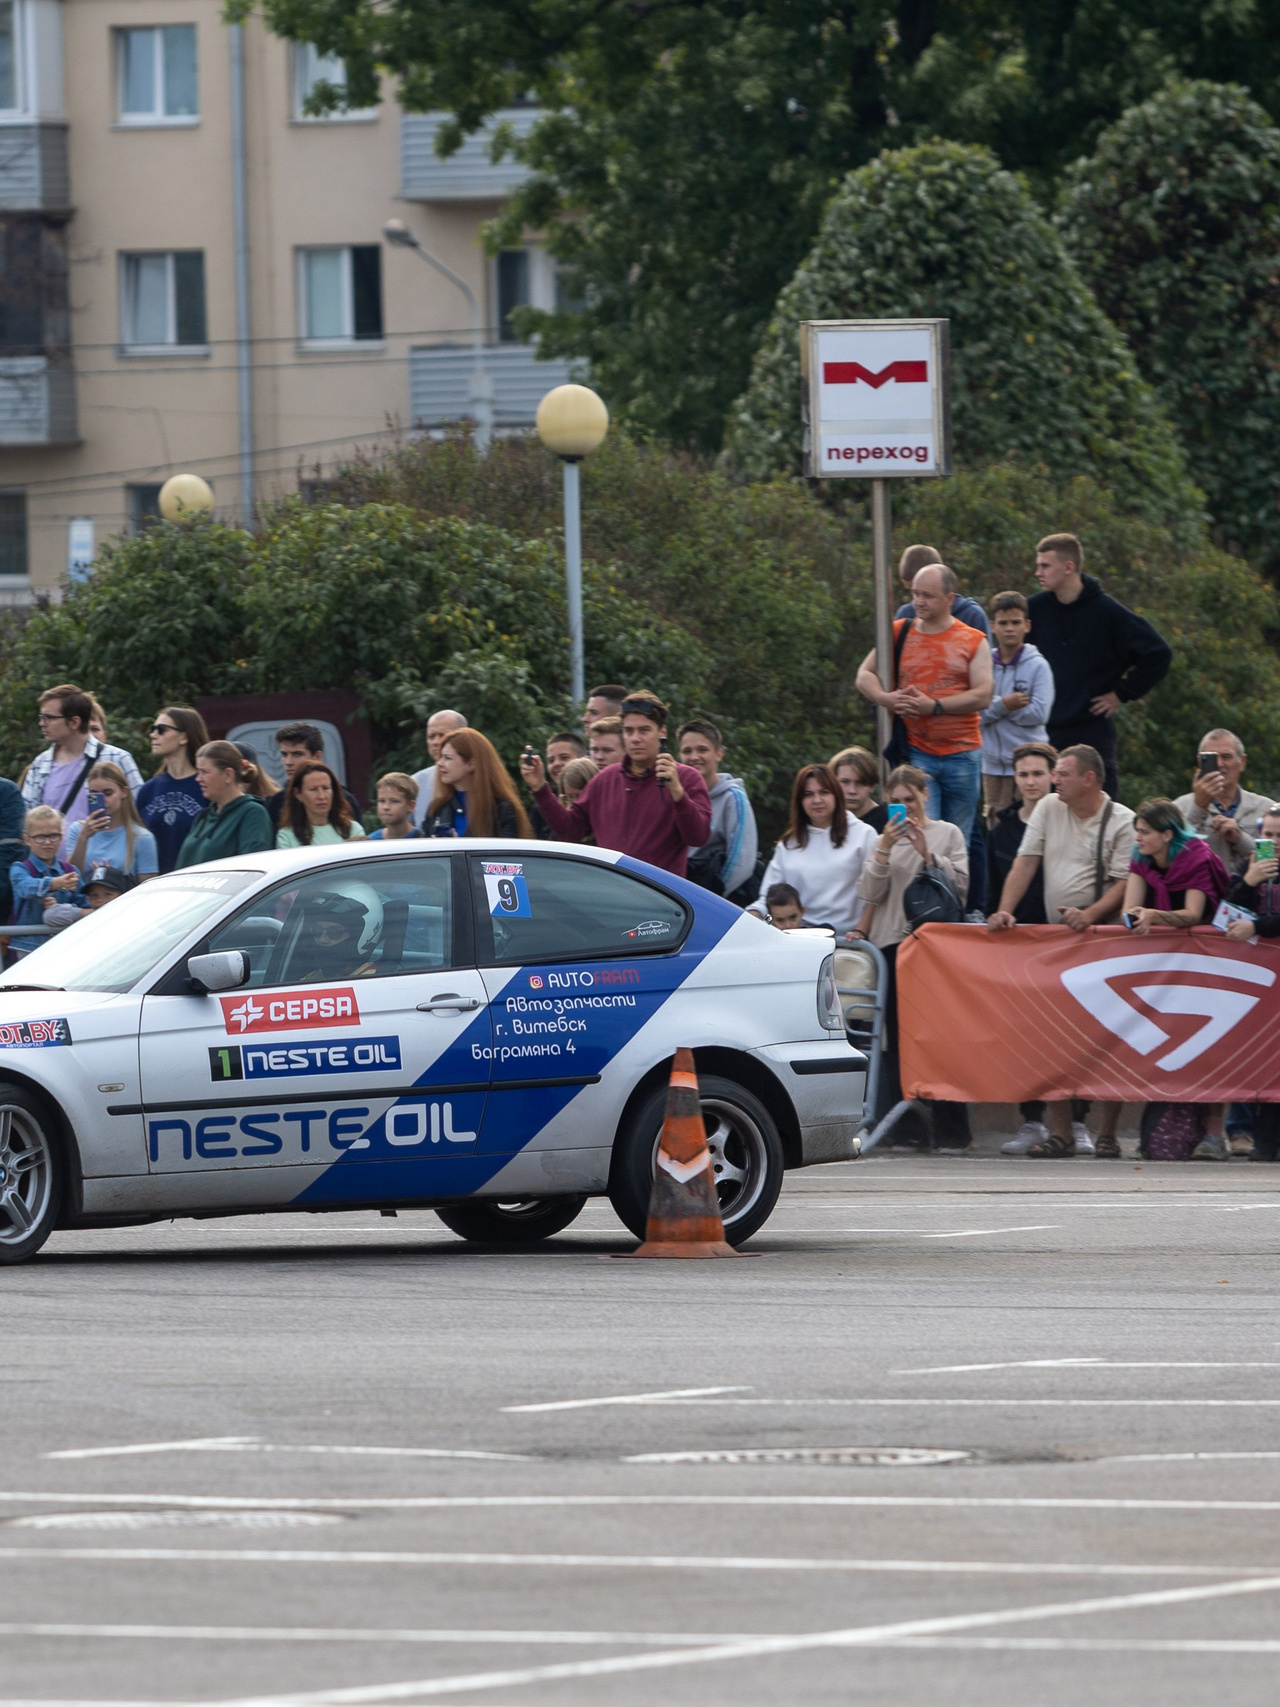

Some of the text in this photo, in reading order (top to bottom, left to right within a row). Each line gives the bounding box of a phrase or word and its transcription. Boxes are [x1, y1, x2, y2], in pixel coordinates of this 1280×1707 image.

[827, 446, 929, 463] переход
[497, 878, 519, 912] 9
[269, 996, 353, 1022] CEPSA
[512, 1016, 588, 1035] Витебск
[565, 1039, 577, 1054] 4
[217, 1044, 397, 1078] 1 NESTE OIL
[148, 1101, 477, 1162] NESTE OIL
